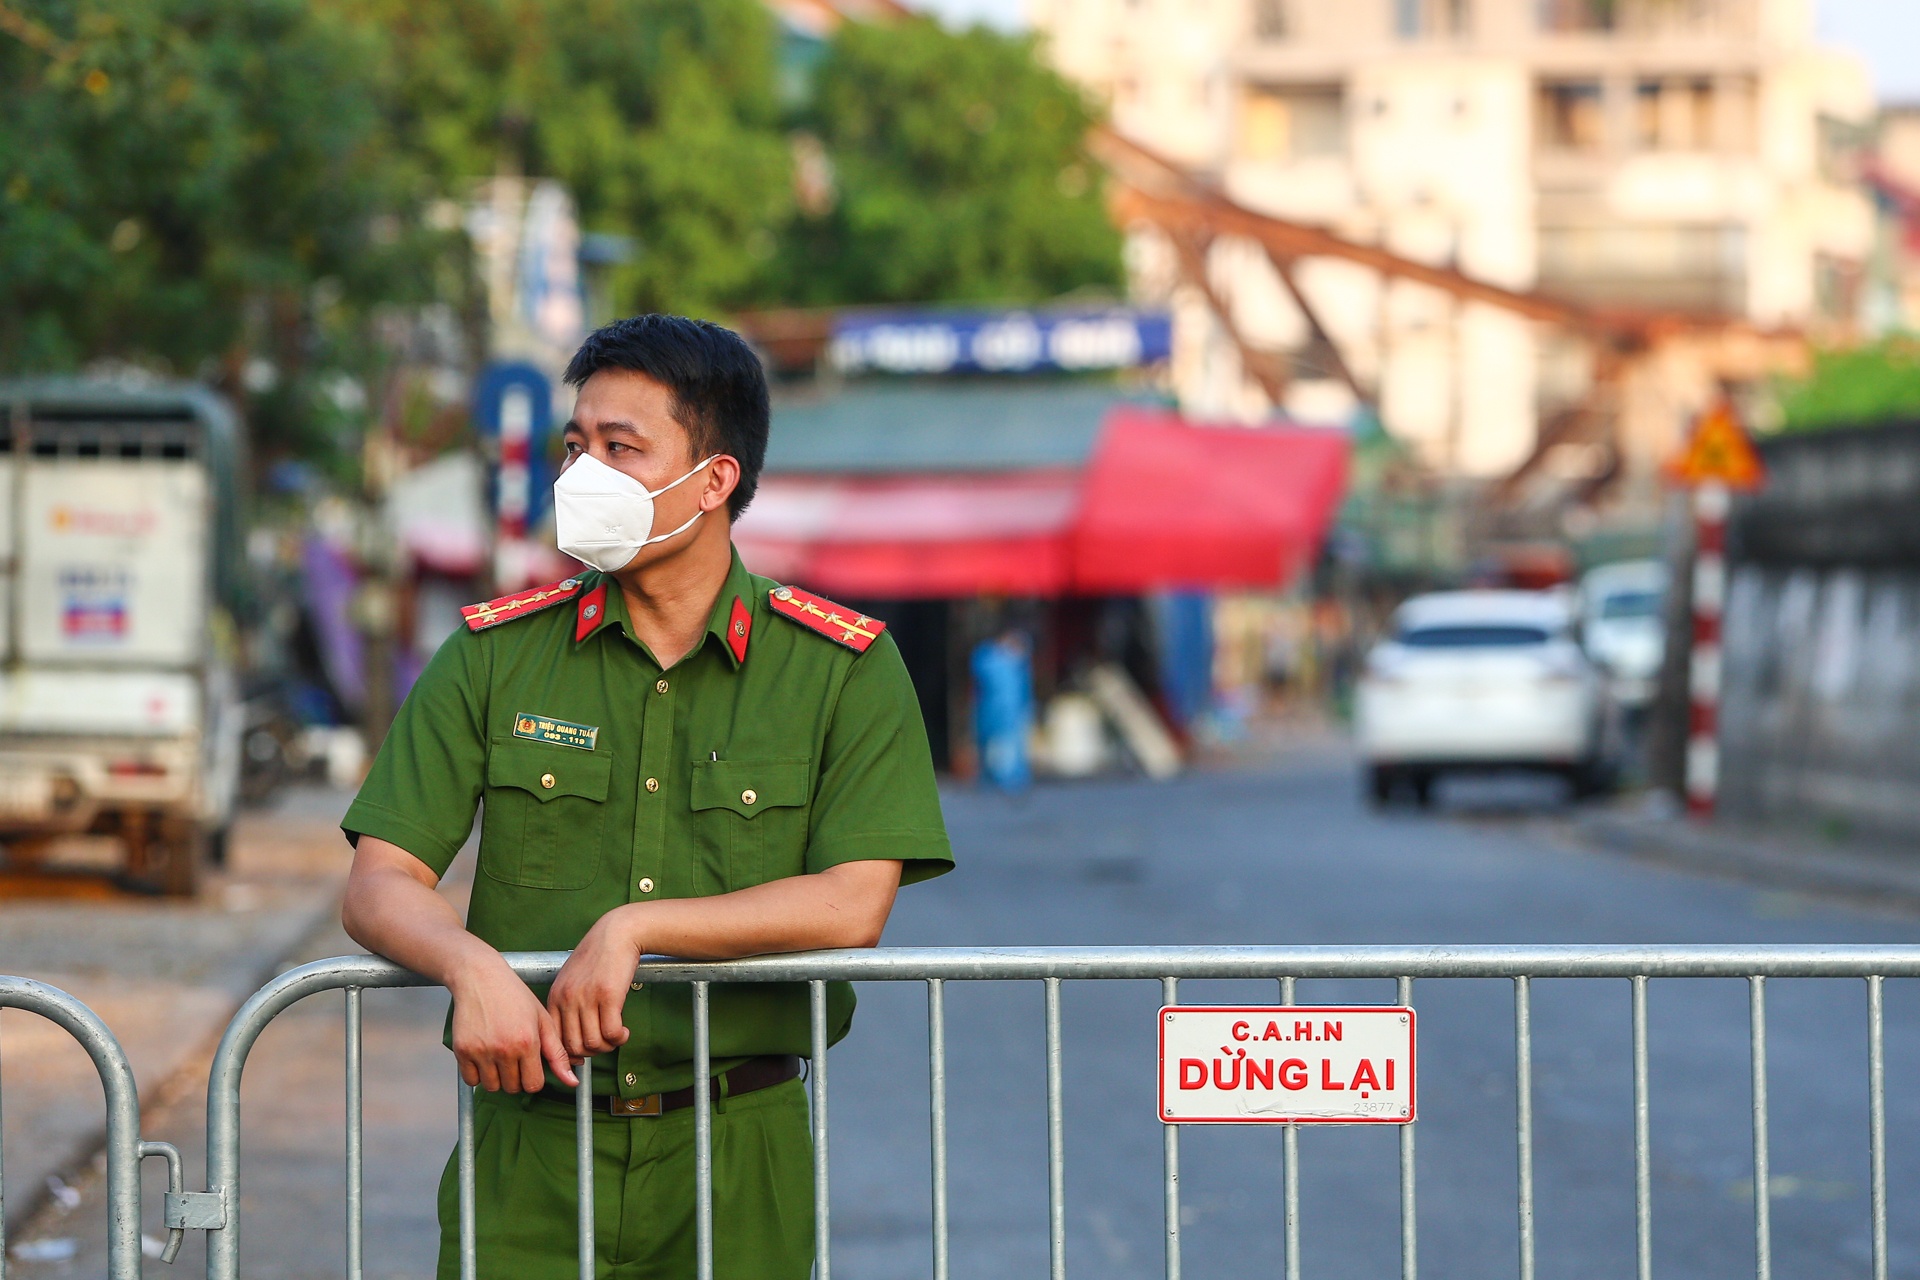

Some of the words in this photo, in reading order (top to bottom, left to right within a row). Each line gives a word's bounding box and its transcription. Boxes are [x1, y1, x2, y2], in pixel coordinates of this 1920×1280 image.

[556, 725, 577, 735] QUANG
[544, 732, 561, 740] 093
[569, 736, 585, 745] 119
[1232, 1020, 1342, 1042] C.A.H.N
[1179, 1046, 1308, 1091] DỪNG
[1322, 1058, 1395, 1098] LẠI
[1353, 1102, 1394, 1113] 23877
